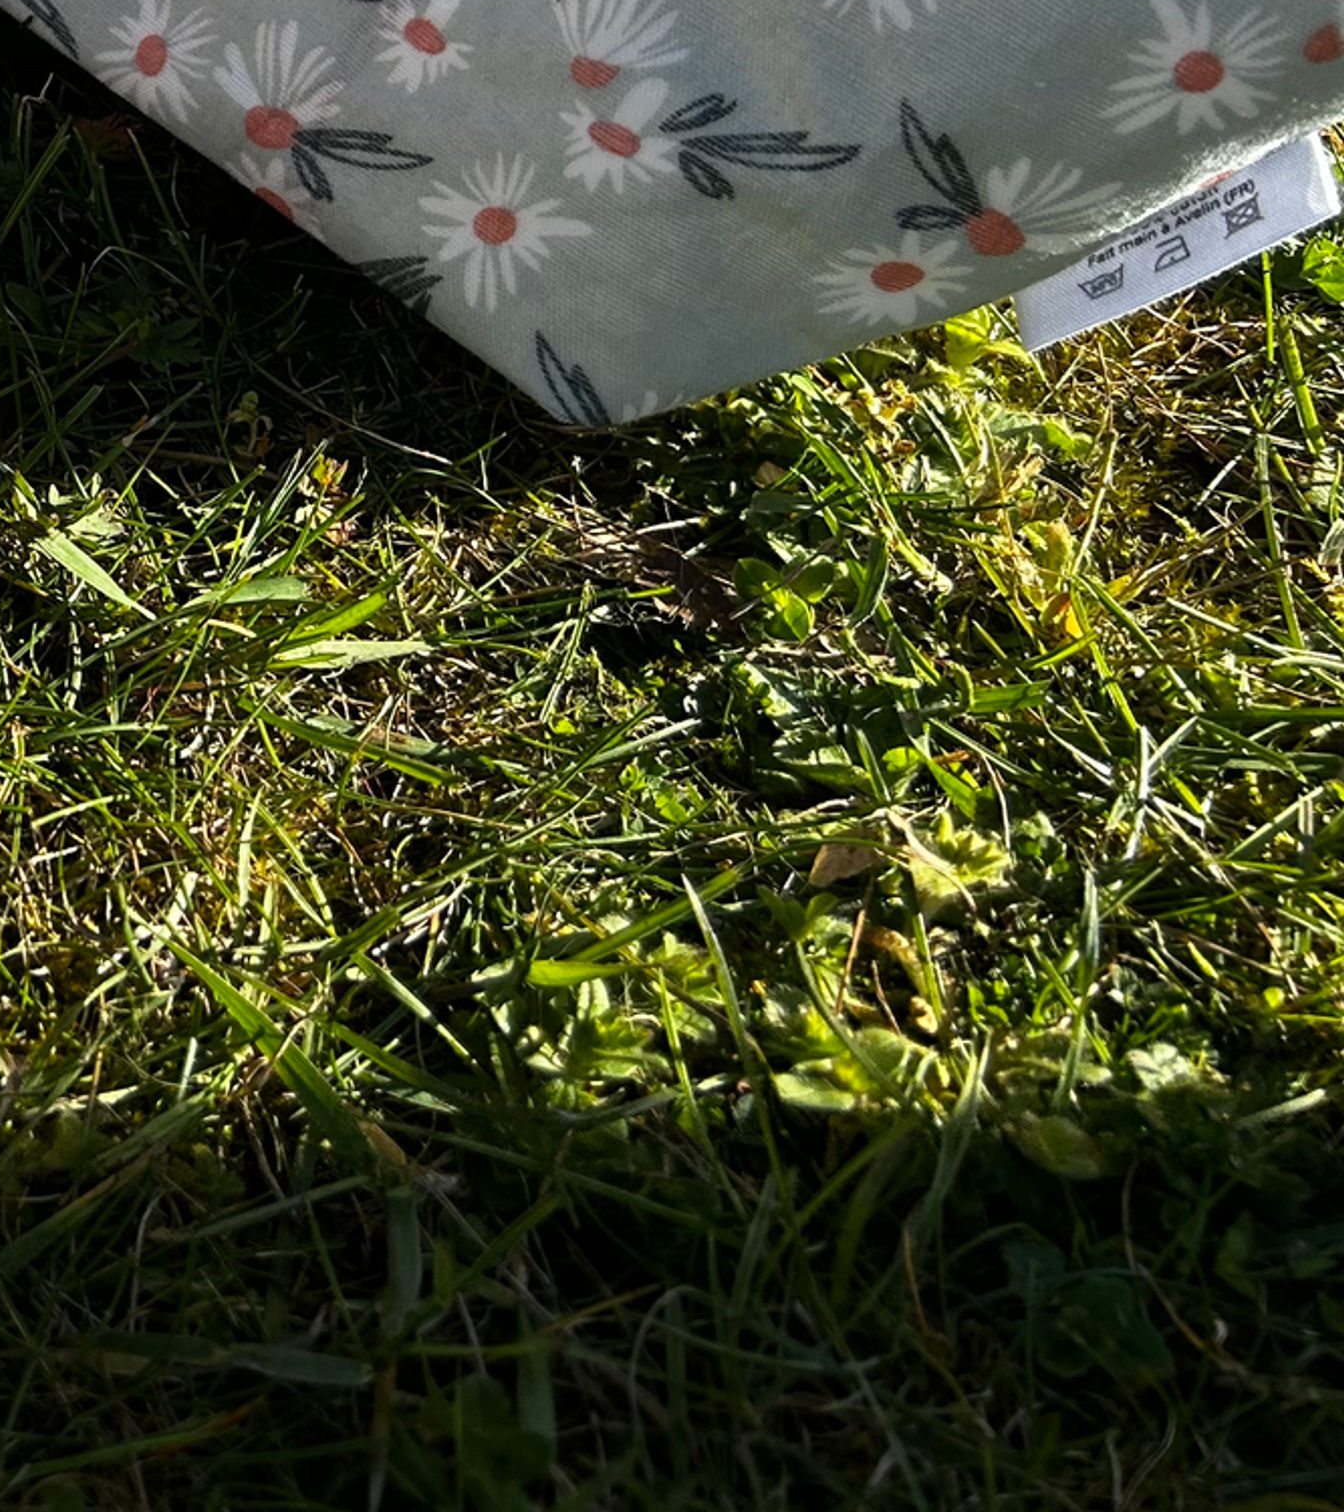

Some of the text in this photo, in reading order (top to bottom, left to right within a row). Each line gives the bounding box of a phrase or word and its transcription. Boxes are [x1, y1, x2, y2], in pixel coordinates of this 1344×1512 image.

[1119, 228, 1158, 254] main
[1175, 199, 1221, 228] Avelin
[1223, 179, 1255, 206] (FR)
